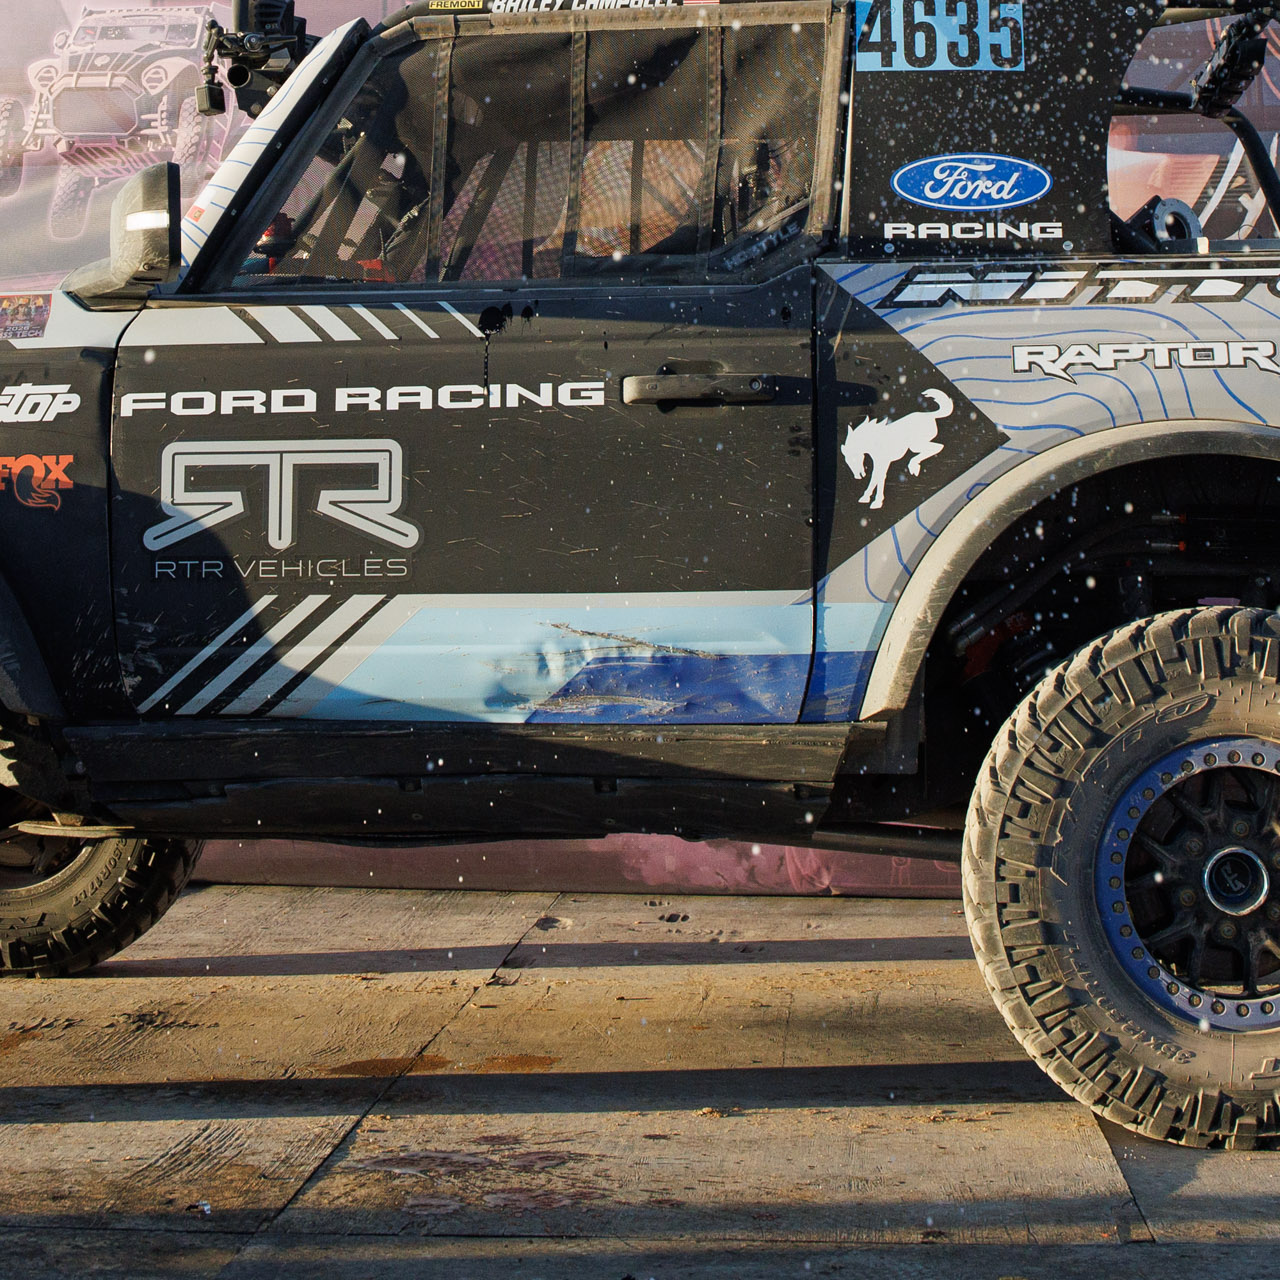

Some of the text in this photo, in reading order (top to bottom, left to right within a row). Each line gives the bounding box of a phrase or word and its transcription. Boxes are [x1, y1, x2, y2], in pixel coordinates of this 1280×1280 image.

[429, 0, 482, 9] FREMONT
[923, 161, 1018, 201] Ford
[883, 222, 1064, 240] RACING
[14, 330, 43, 338] TECH
[120, 381, 606, 418] FORD RACING
[154, 557, 408, 579] RTR VEHICLES
